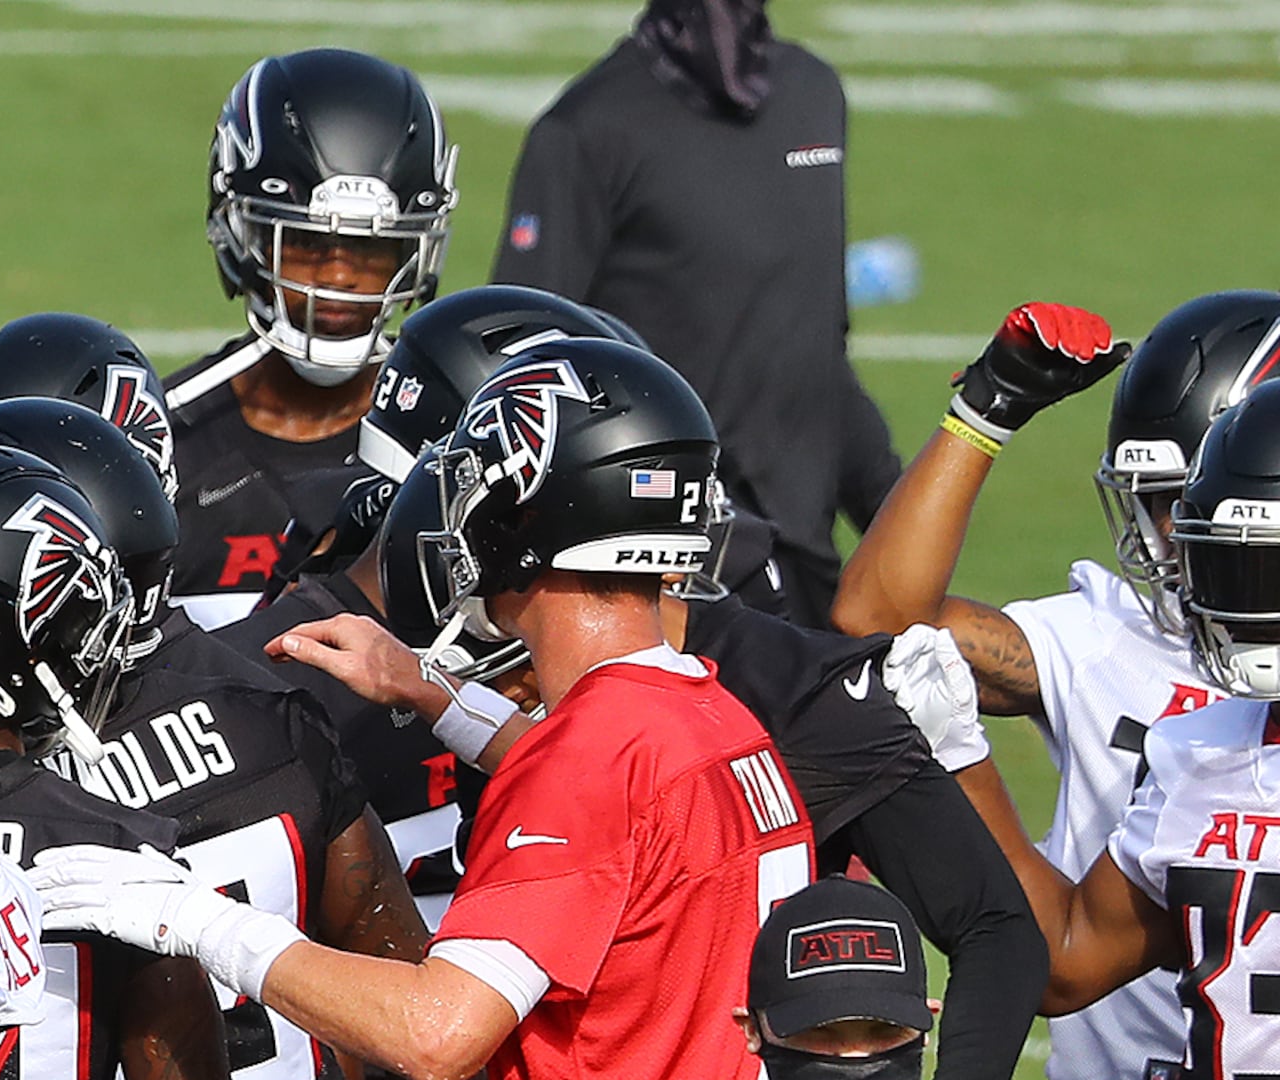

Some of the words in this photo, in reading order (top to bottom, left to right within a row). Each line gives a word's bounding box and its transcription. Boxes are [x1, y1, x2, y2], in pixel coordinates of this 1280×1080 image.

[336, 180, 377, 195] ATL
[1125, 448, 1157, 464] ATL
[680, 481, 702, 523] 2
[1231, 504, 1271, 520] ATL
[799, 931, 894, 966] ATL
